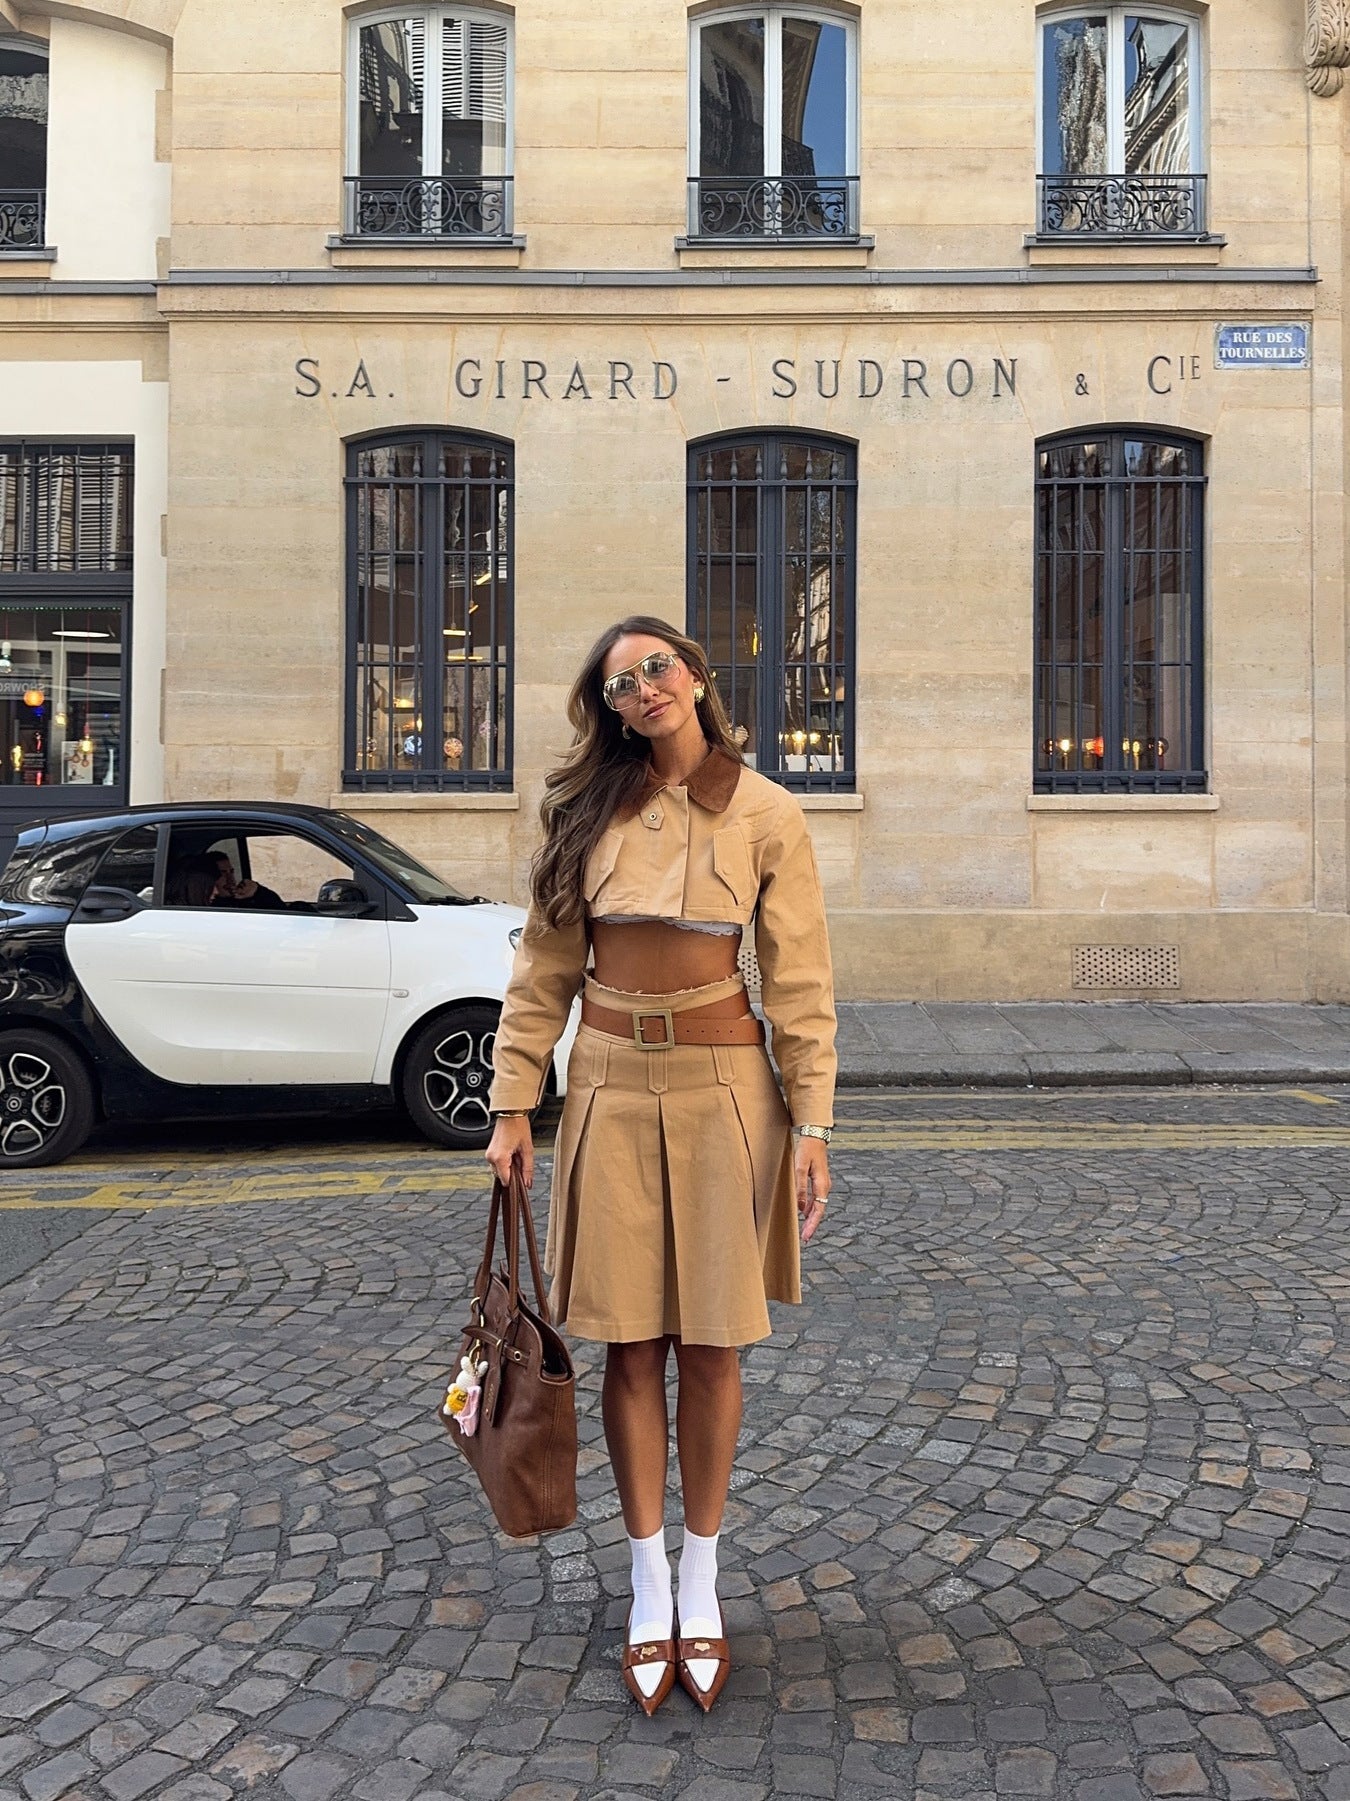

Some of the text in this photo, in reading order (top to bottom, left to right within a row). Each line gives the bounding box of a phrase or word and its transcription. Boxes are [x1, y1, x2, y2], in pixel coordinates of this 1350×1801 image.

[1233, 332, 1293, 343] RUE DES
[1220, 347, 1306, 359] TOURNELLES
[295, 358, 395, 399] S.A.
[455, 358, 678, 400] GIRARD
[771, 358, 1019, 399] SUDRON
[1074, 372, 1091, 397] &
